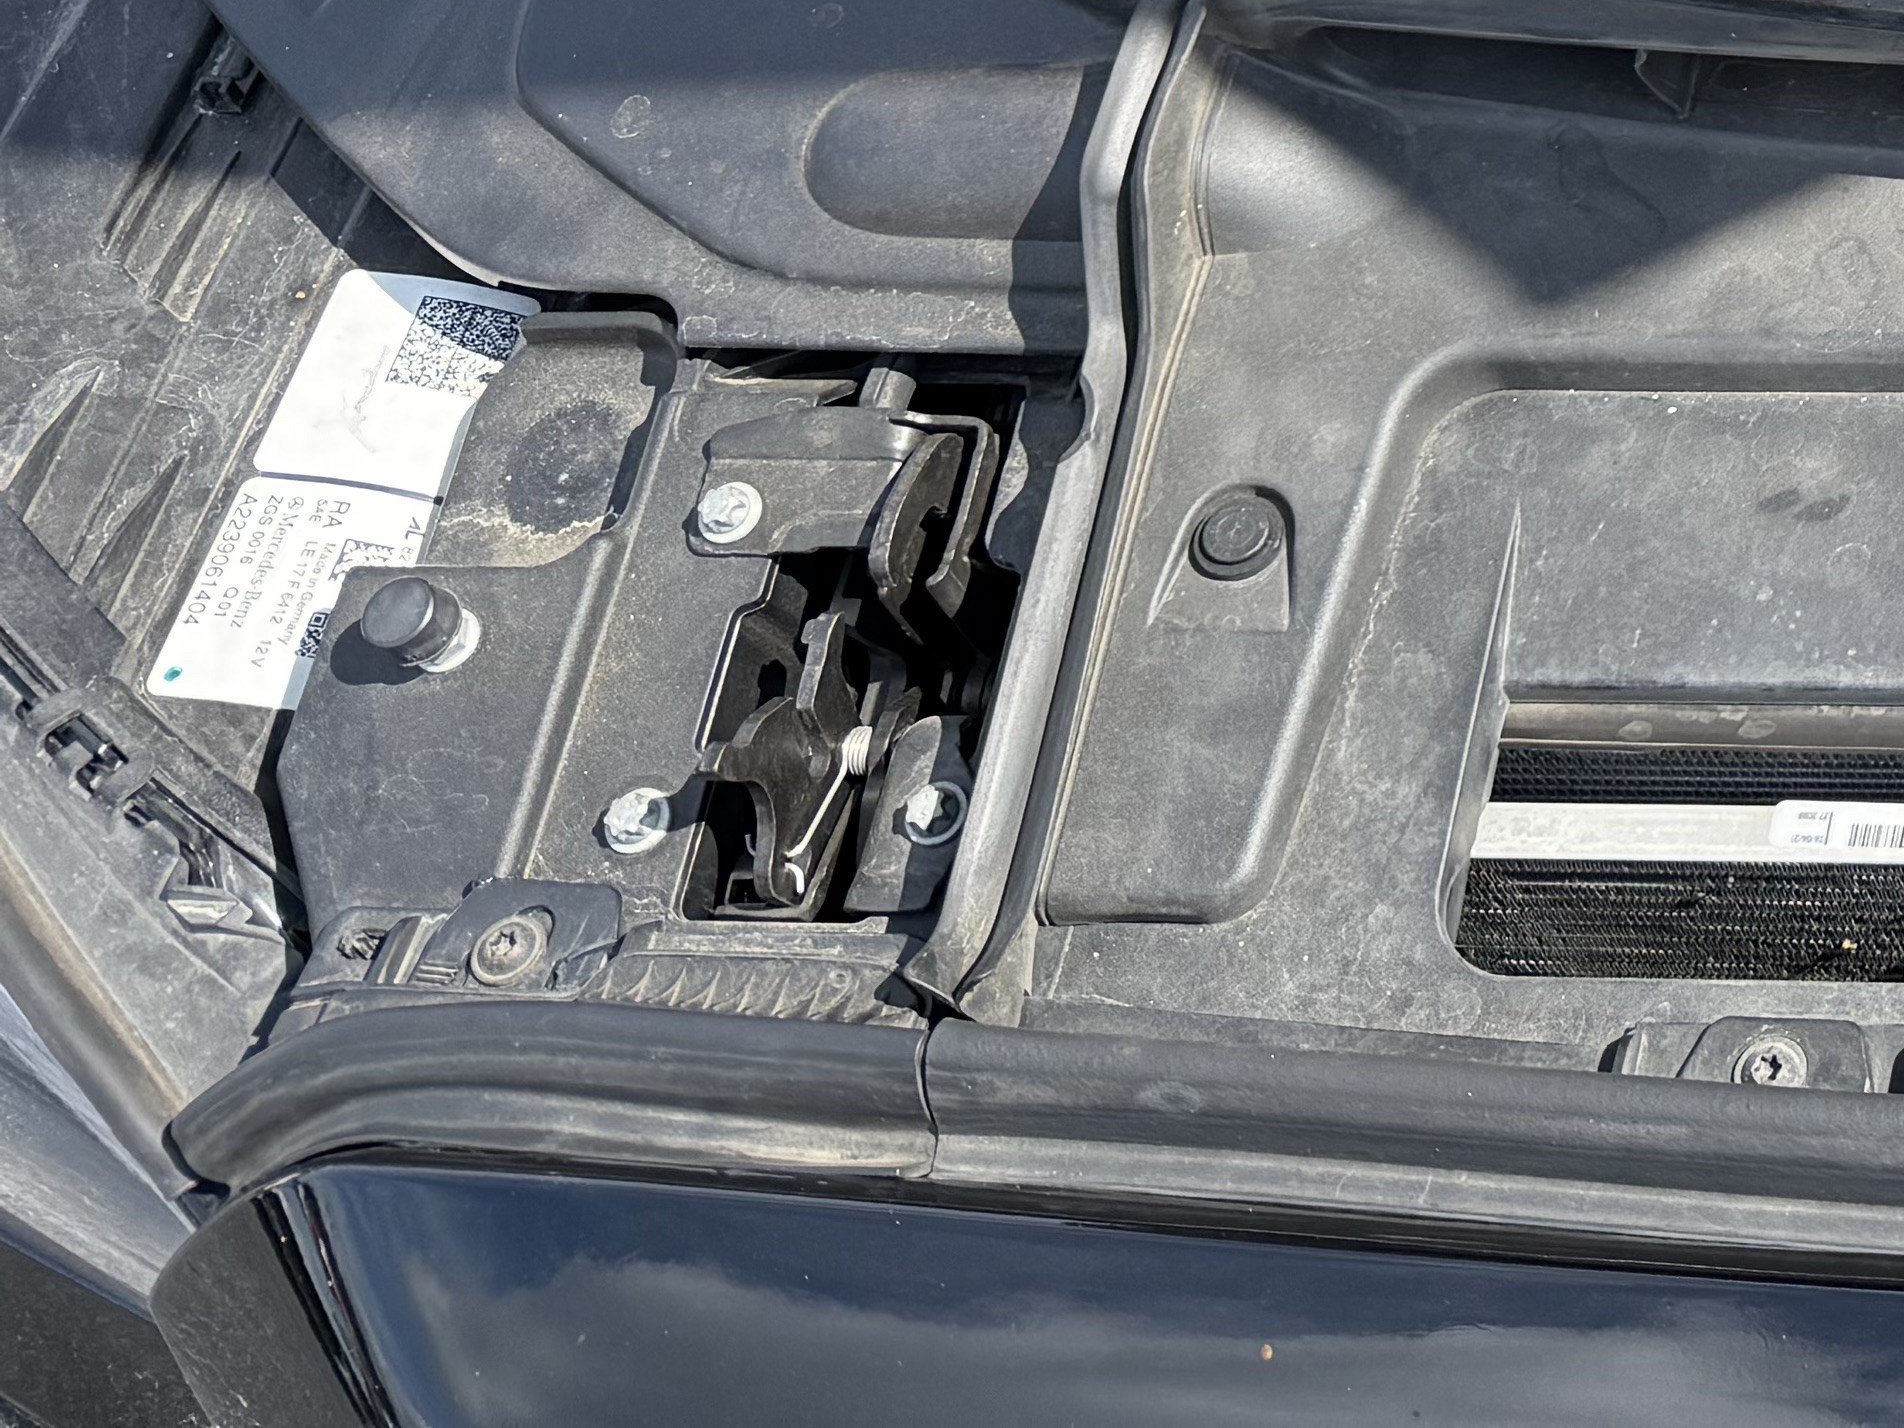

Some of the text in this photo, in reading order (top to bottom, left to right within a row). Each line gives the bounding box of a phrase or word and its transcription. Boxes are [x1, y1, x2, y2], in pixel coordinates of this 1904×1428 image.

[256, 494, 284, 527] ZGS
[322, 499, 352, 530] RA
[182, 492, 258, 626] A2239061404
[239, 530, 266, 566] 0016
[229, 513, 299, 629] Mercedes-Benz
[269, 590, 295, 626] 6412
[283, 590, 314, 647] Germany
